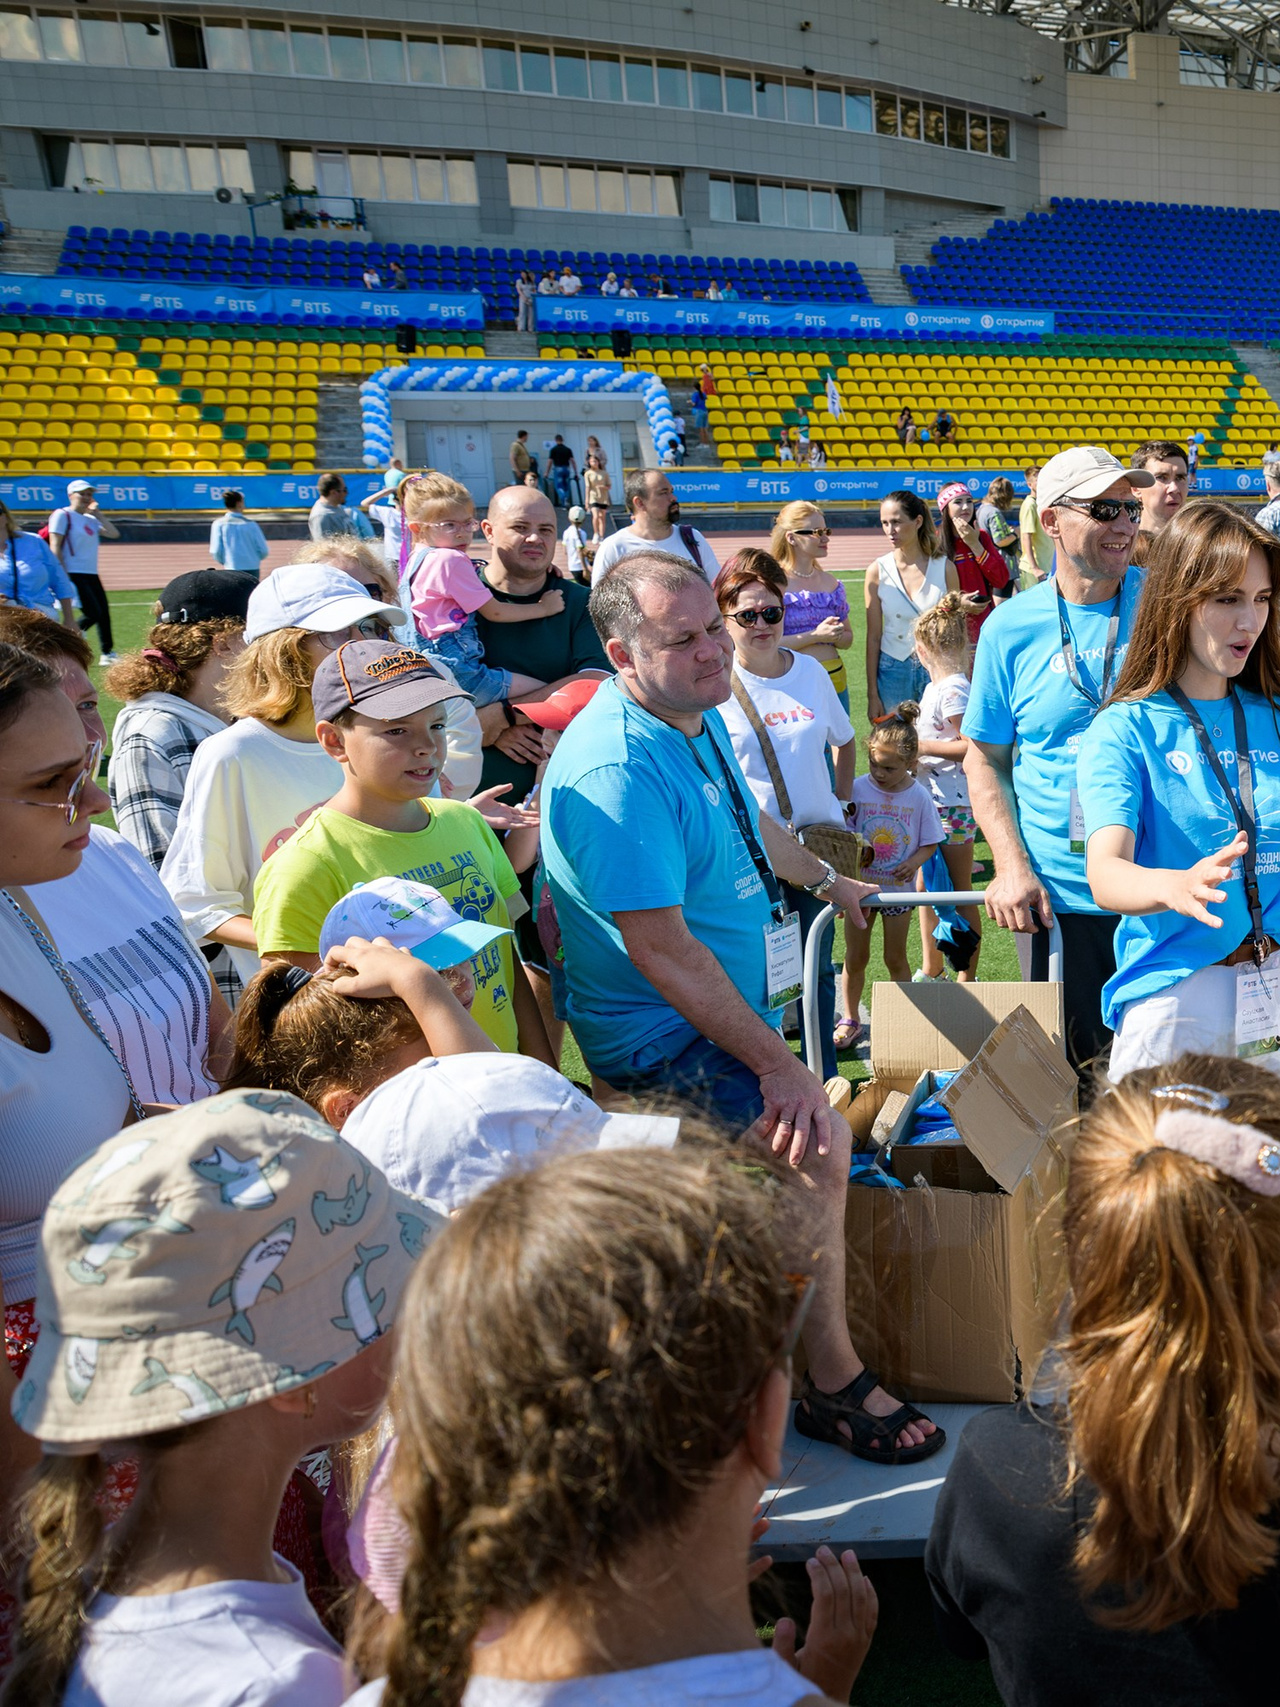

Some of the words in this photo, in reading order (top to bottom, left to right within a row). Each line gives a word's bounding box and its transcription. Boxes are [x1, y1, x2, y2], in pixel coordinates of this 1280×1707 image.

[75, 293, 106, 306] ВТБ
[153, 296, 183, 309] ВТБ
[228, 299, 257, 312] ВТБ
[303, 301, 332, 314] ВТБ
[373, 304, 400, 316] ВТБ
[440, 305, 466, 318] ВТБ
[564, 309, 589, 321] ВТБ
[626, 311, 650, 323] ВТБ
[686, 312, 710, 324] ВТБ
[747, 313, 771, 326] ВТБ
[804, 315, 827, 327] ВТБ
[920, 314, 972, 326] открытие
[860, 316, 882, 328] ВТБ
[995, 317, 1046, 328] открытие
[760, 481, 790, 495] ВТБ
[829, 480, 879, 492] открытие
[16, 486, 55, 501] ВТБ
[113, 486, 149, 501] ВТБ
